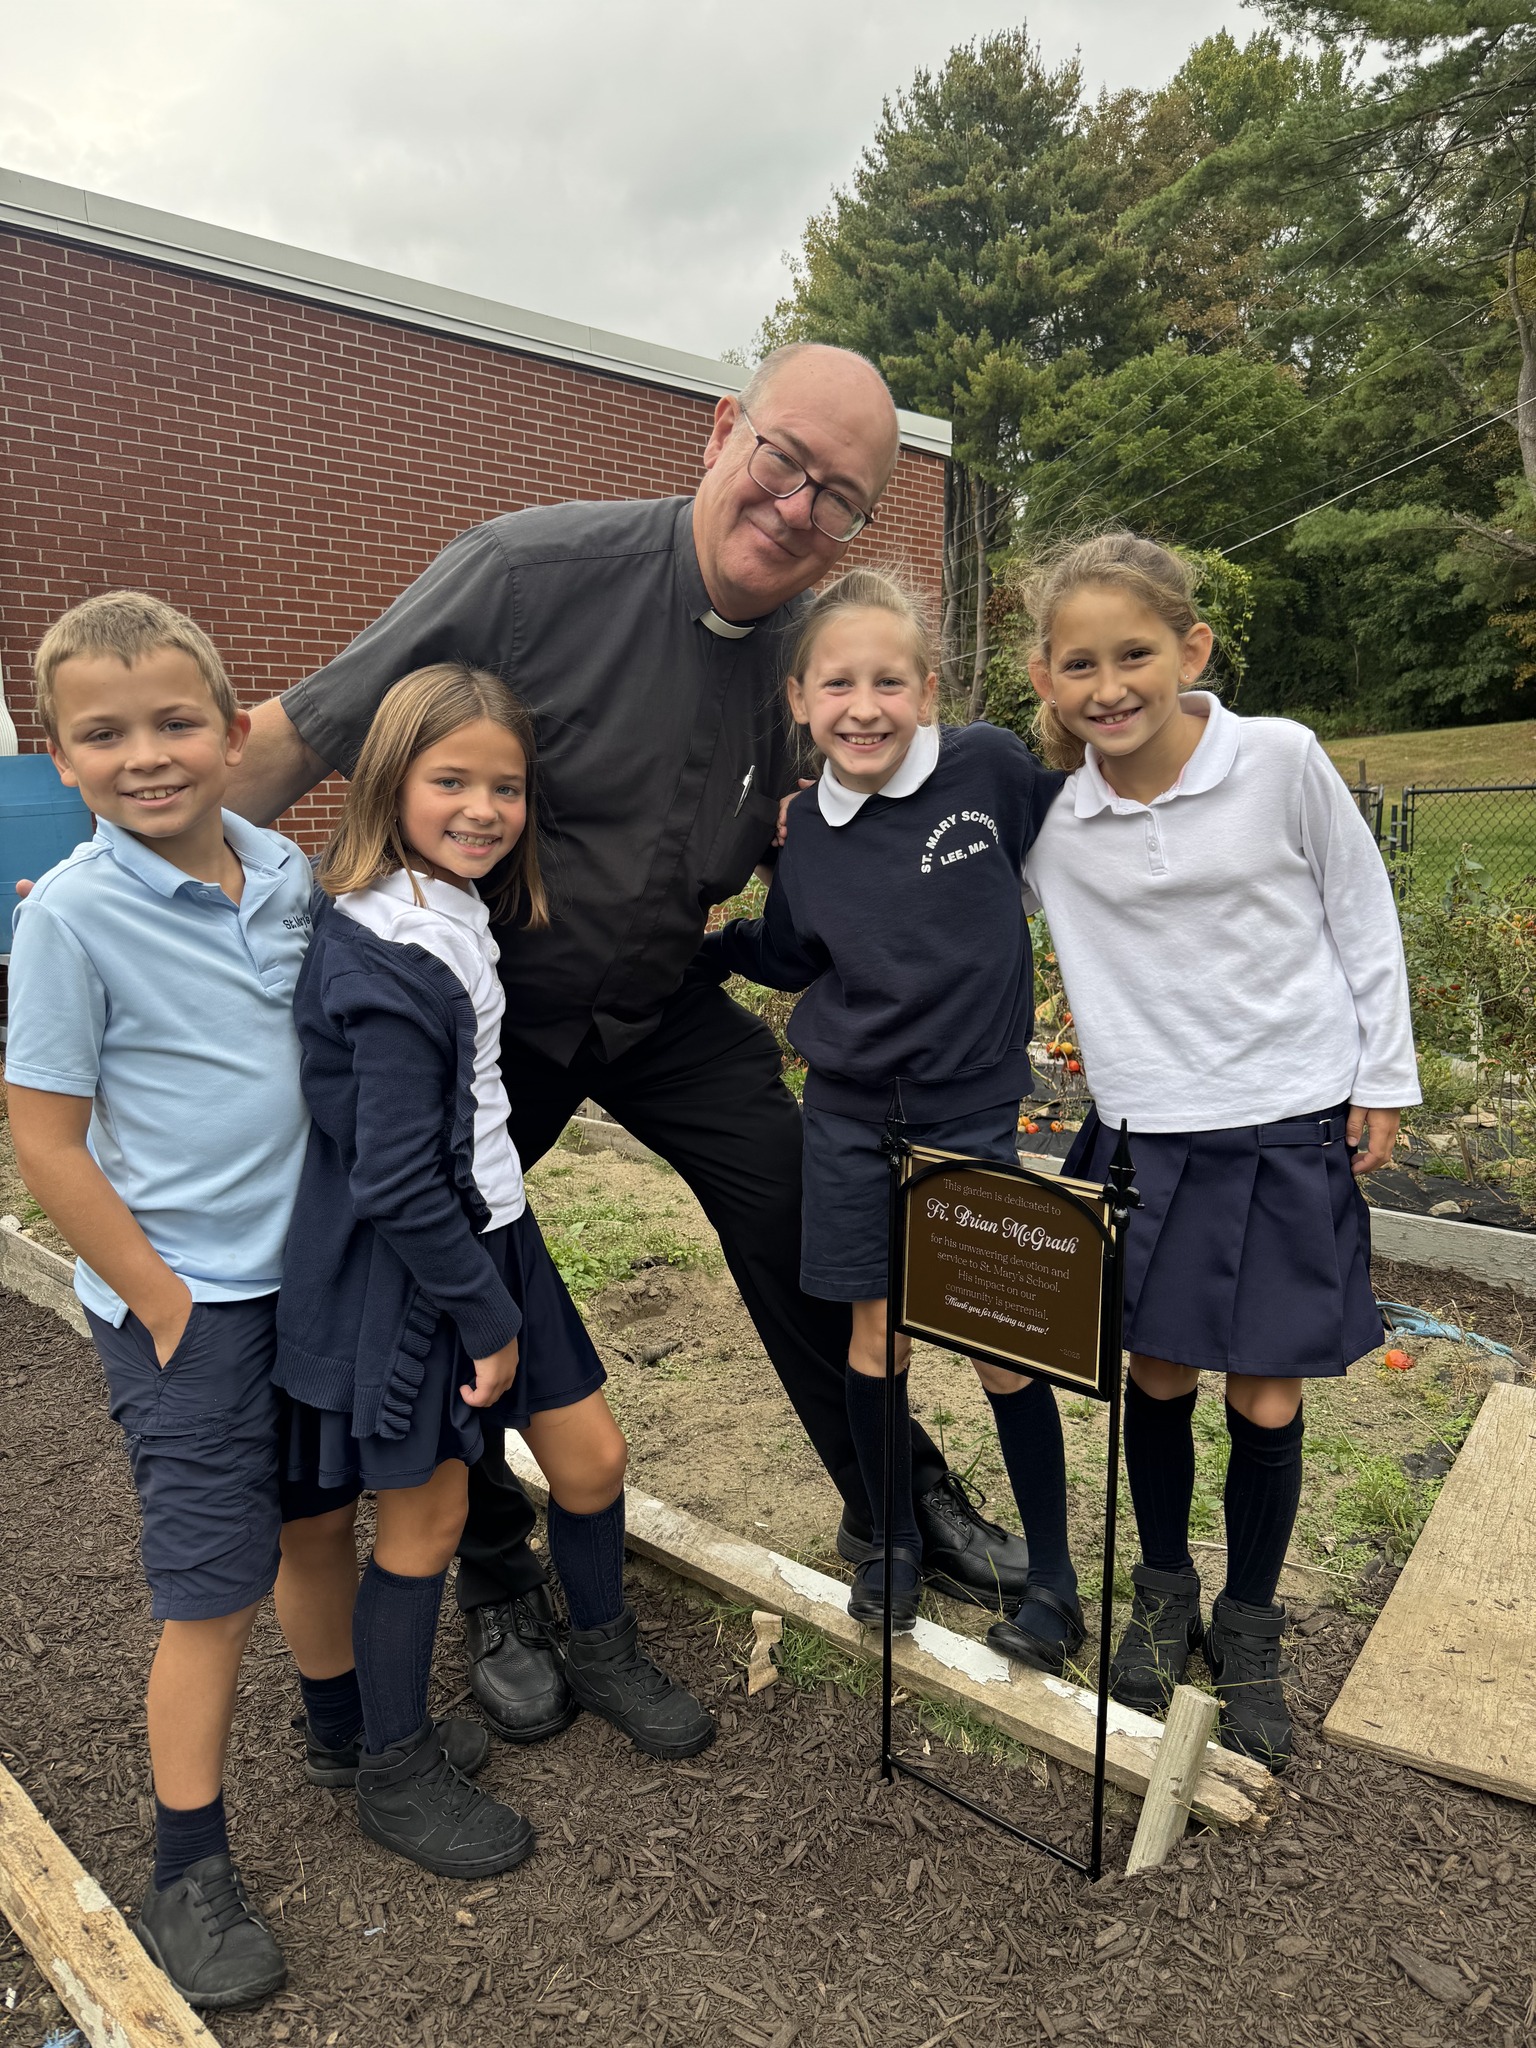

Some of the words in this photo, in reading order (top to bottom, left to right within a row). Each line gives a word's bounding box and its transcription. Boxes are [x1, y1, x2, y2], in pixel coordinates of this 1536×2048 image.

[926, 814, 957, 849] MARY
[921, 853, 933, 873] ST.
[940, 849, 968, 866] LEE,
[968, 840, 989, 855] MA.
[943, 1178, 962, 1192] This
[963, 1183, 993, 1200] garden
[994, 1190, 1003, 1202] is
[1004, 1193, 1050, 1213] dedicated
[1050, 1206, 1061, 1216] to
[926, 1197, 949, 1222] Fr.
[954, 1204, 998, 1234] Brian
[1001, 1216, 1079, 1254] McGrath
[930, 1233, 943, 1244] for
[944, 1236, 957, 1249] his
[958, 1241, 1009, 1266] unwavering
[1010, 1252, 1049, 1274] devotion
[1051, 1266, 1070, 1280] and
[937, 1251, 968, 1266] service
[969, 1258, 978, 1269] to
[980, 1261, 991, 1273] St.
[993, 1264, 1025, 1284] Mary's
[1026, 1273, 1061, 1293] School.
[945, 1282, 994, 1305] community
[995, 1295, 1003, 1306] is
[1004, 1299, 1049, 1321] perrenial.
[958, 1269, 973, 1283] His
[974, 1274, 1005, 1290] impact
[1006, 1286, 1019, 1296] on
[1020, 1290, 1037, 1301] our
[944, 1294, 968, 1311] Thank
[968, 1302, 981, 1315] you
[980, 1304, 991, 1318] for
[991, 1309, 1017, 1327] helping
[1017, 1319, 1026, 1328] us
[1026, 1321, 1050, 1336] grow!
